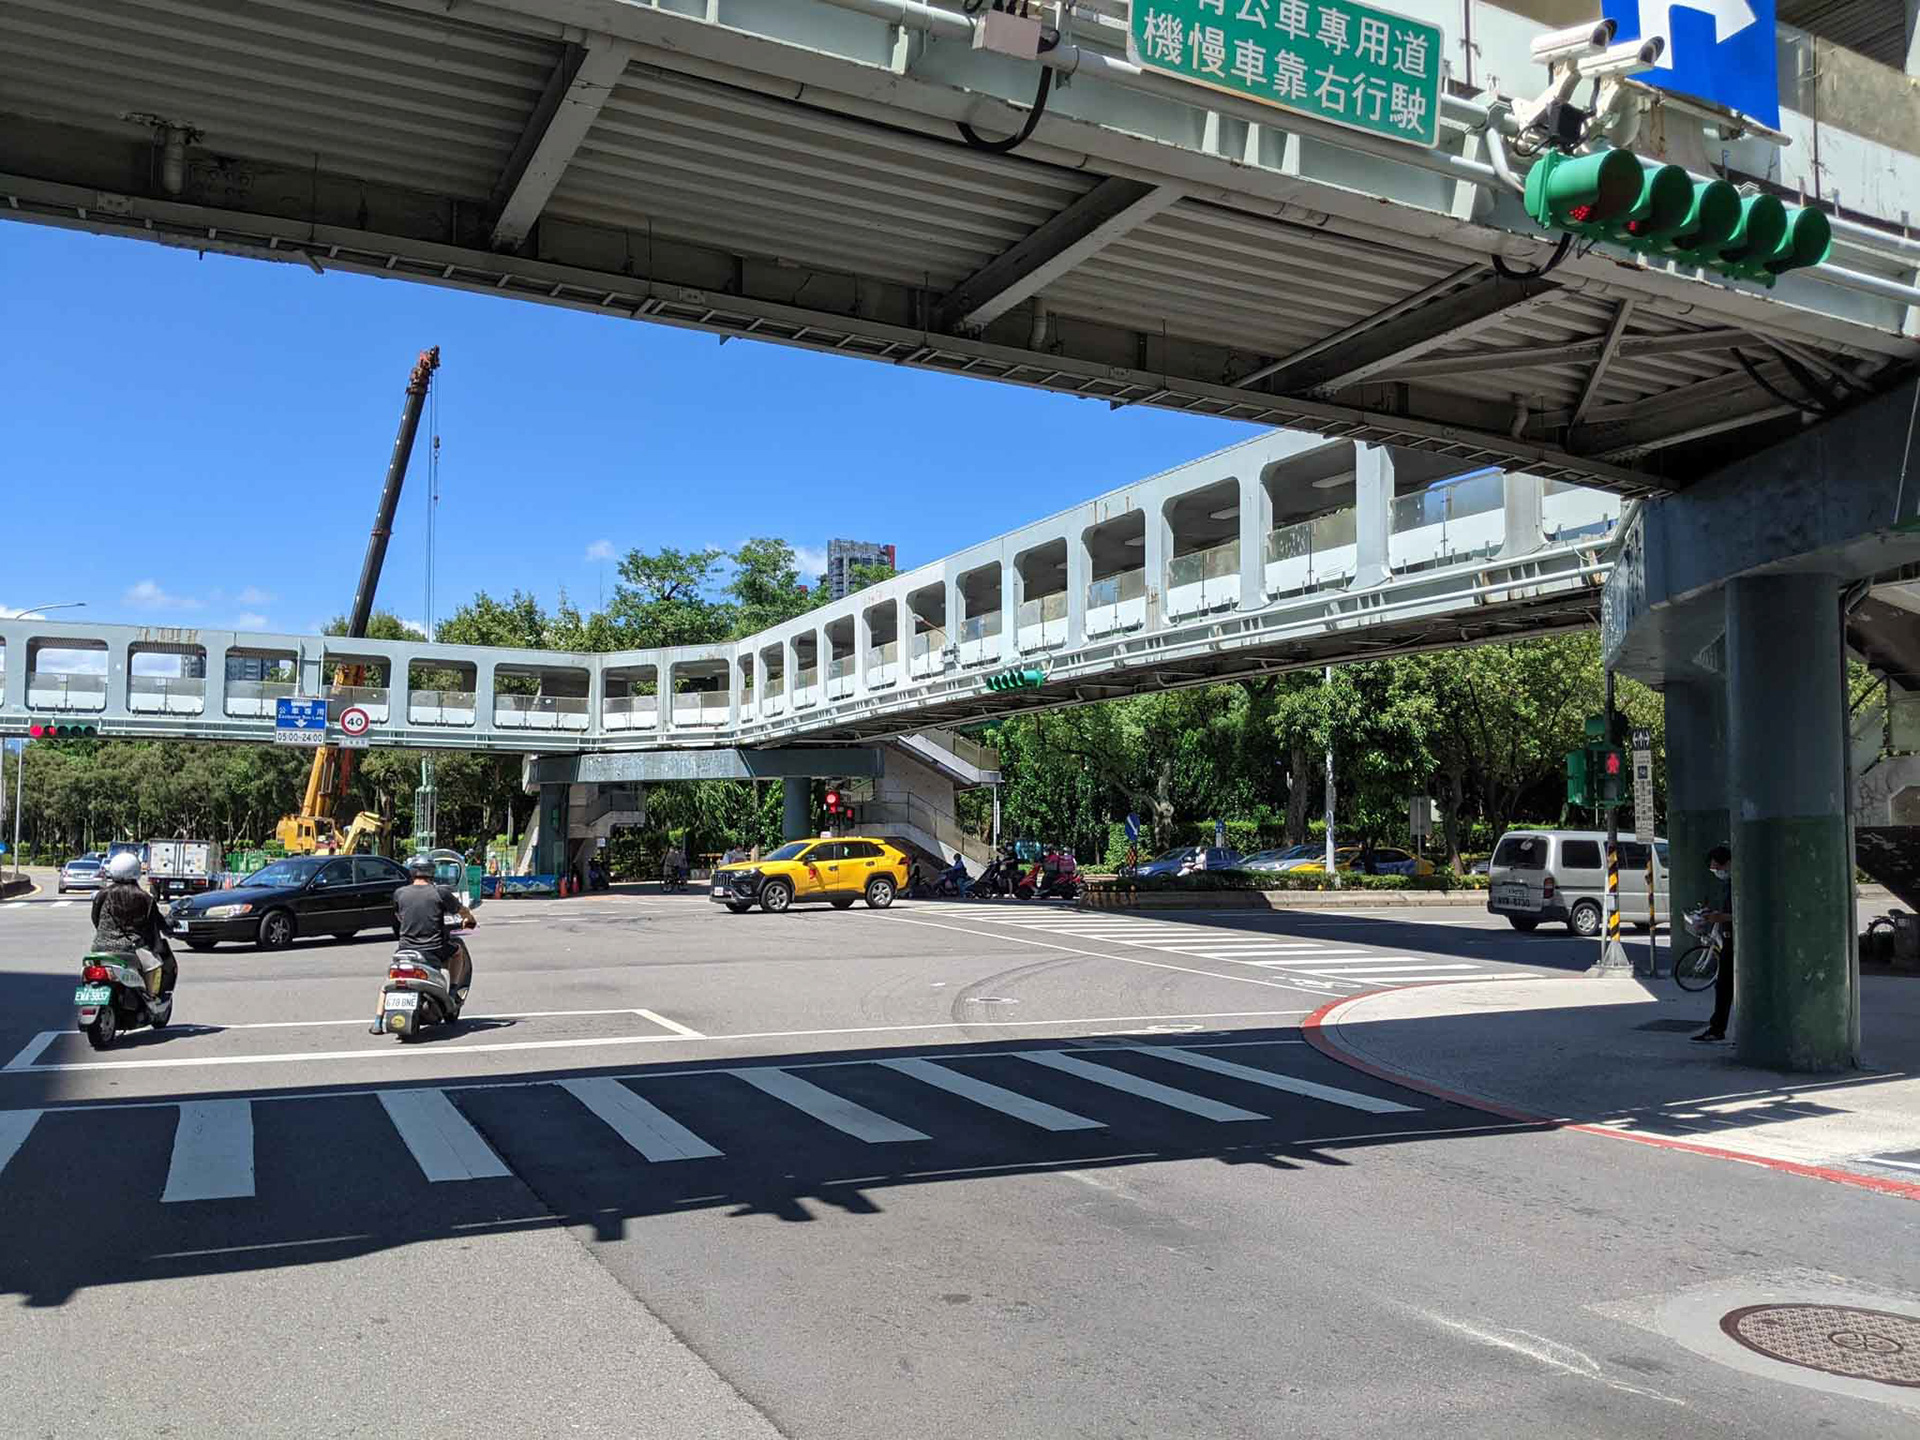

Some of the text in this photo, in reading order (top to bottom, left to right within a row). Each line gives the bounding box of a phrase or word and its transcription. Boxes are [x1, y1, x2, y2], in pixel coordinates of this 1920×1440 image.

[1143, 7, 1426, 134] 機慢車靠右行駛
[1174, 0, 1429, 79] 公車專用道
[347, 717, 363, 726] 40
